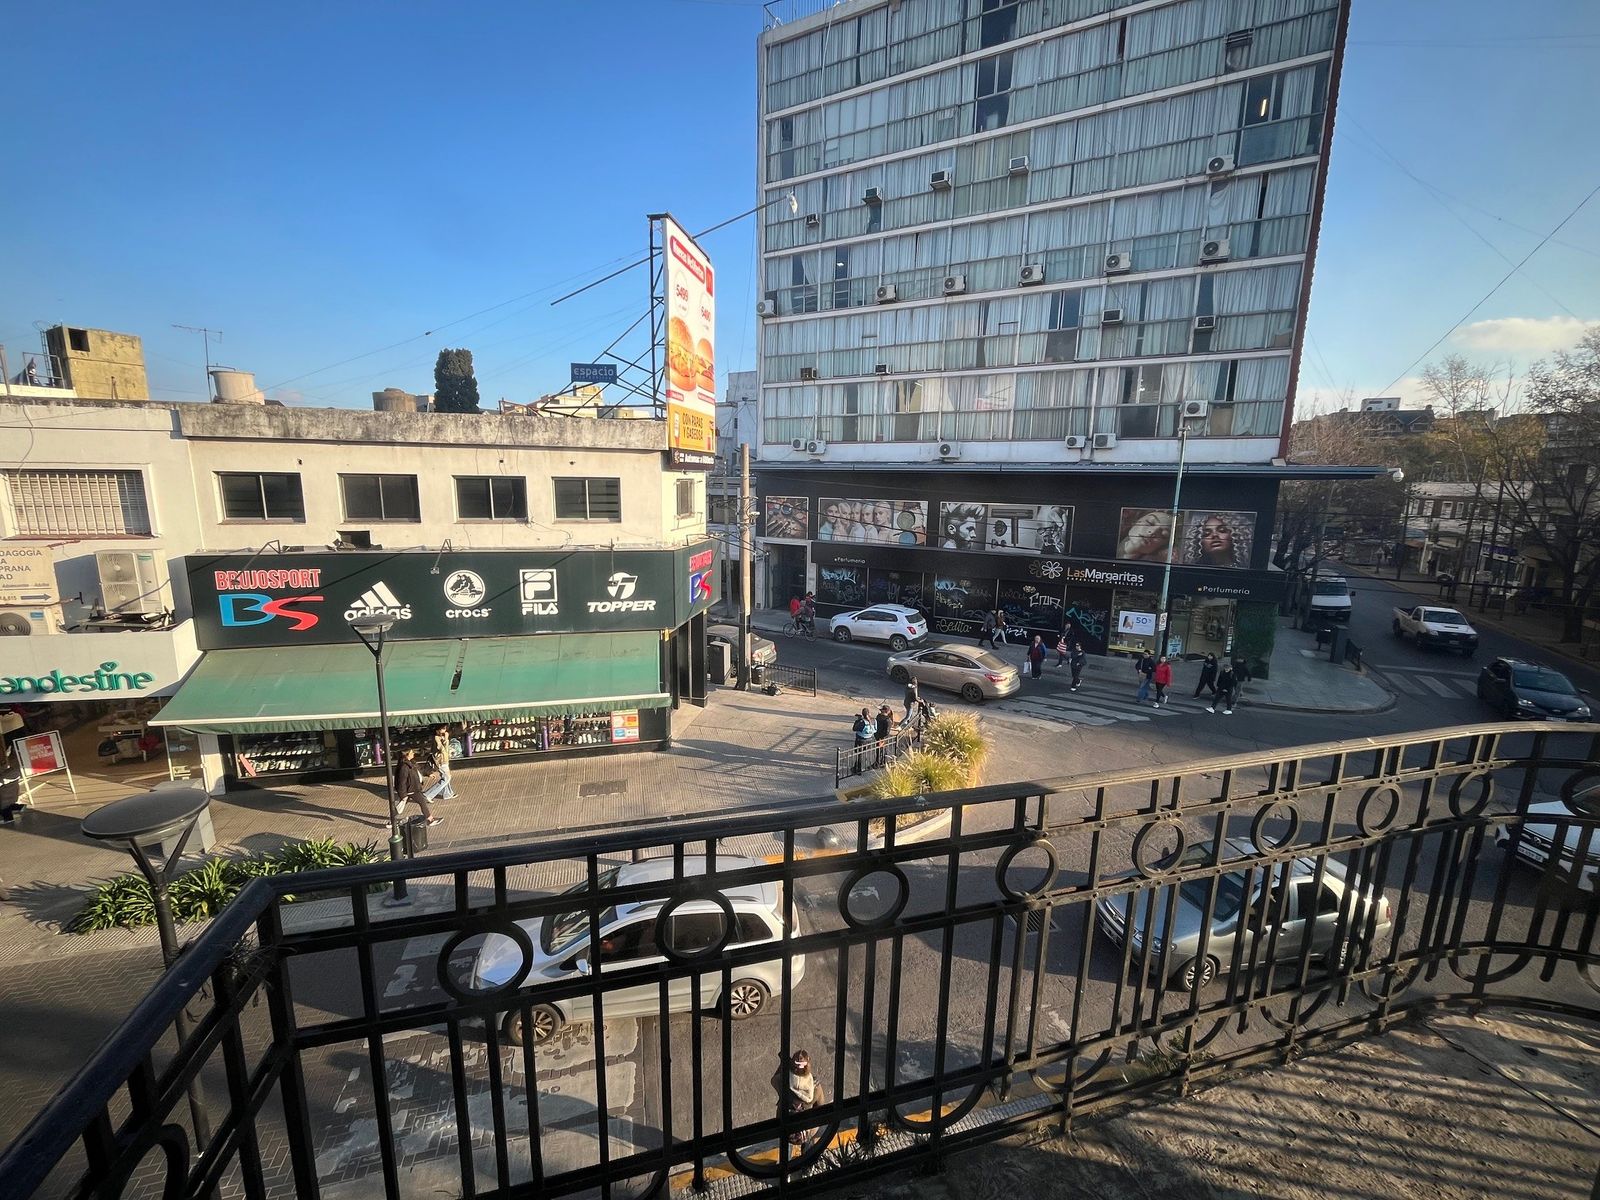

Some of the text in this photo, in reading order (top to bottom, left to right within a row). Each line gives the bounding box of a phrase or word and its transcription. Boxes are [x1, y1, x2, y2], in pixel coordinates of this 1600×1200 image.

[573, 366, 614, 378] espacio
[214, 568, 322, 590] BRUJOSPORT
[521, 603, 559, 615] FILA
[586, 600, 657, 613] TOPPER
[343, 605, 412, 622] adidas
[445, 609, 490, 619] crocs
